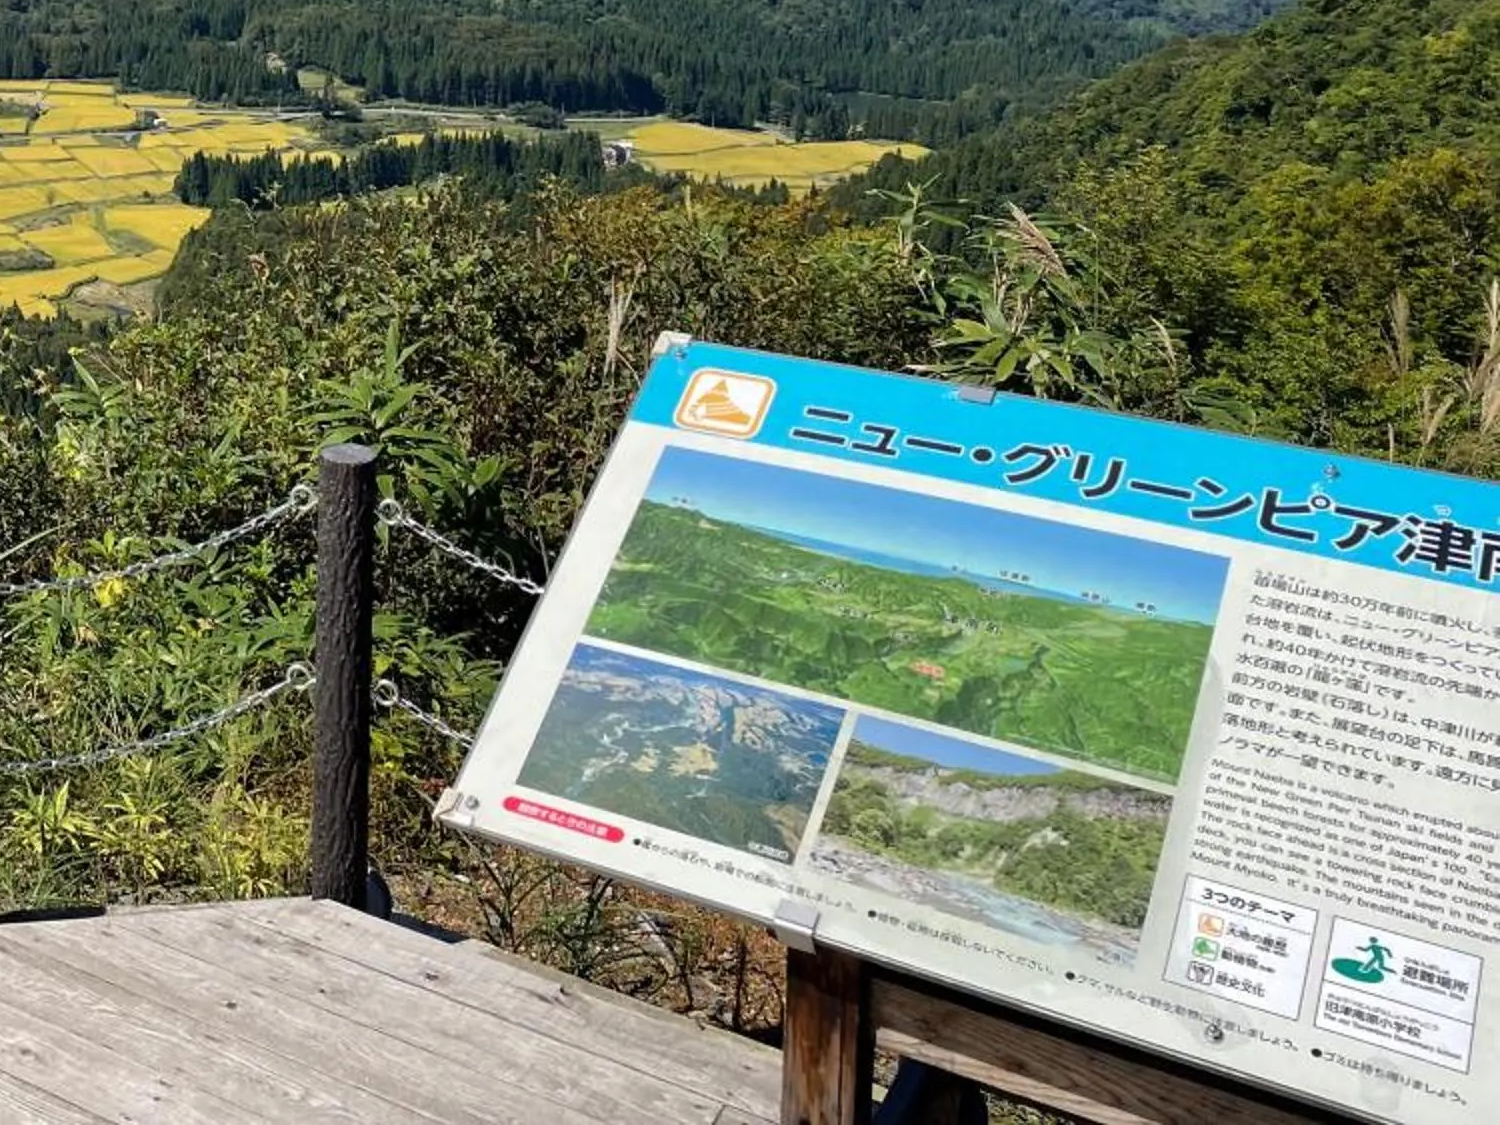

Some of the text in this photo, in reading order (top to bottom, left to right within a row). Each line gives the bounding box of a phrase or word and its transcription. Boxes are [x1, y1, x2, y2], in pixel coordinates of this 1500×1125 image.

[1211, 758, 1251, 775] Mount
[1208, 772, 1222, 781] of
[1225, 776, 1247, 787] the
[1251, 782, 1280, 796] New
[1285, 791, 1323, 808] Green
[1201, 810, 1223, 824] The
[1465, 854, 1483, 864] 40
[1443, 861, 1467, 875] 100
[1201, 888, 1296, 923] 3つのテーマ
[1402, 964, 1470, 995] 避難場所
